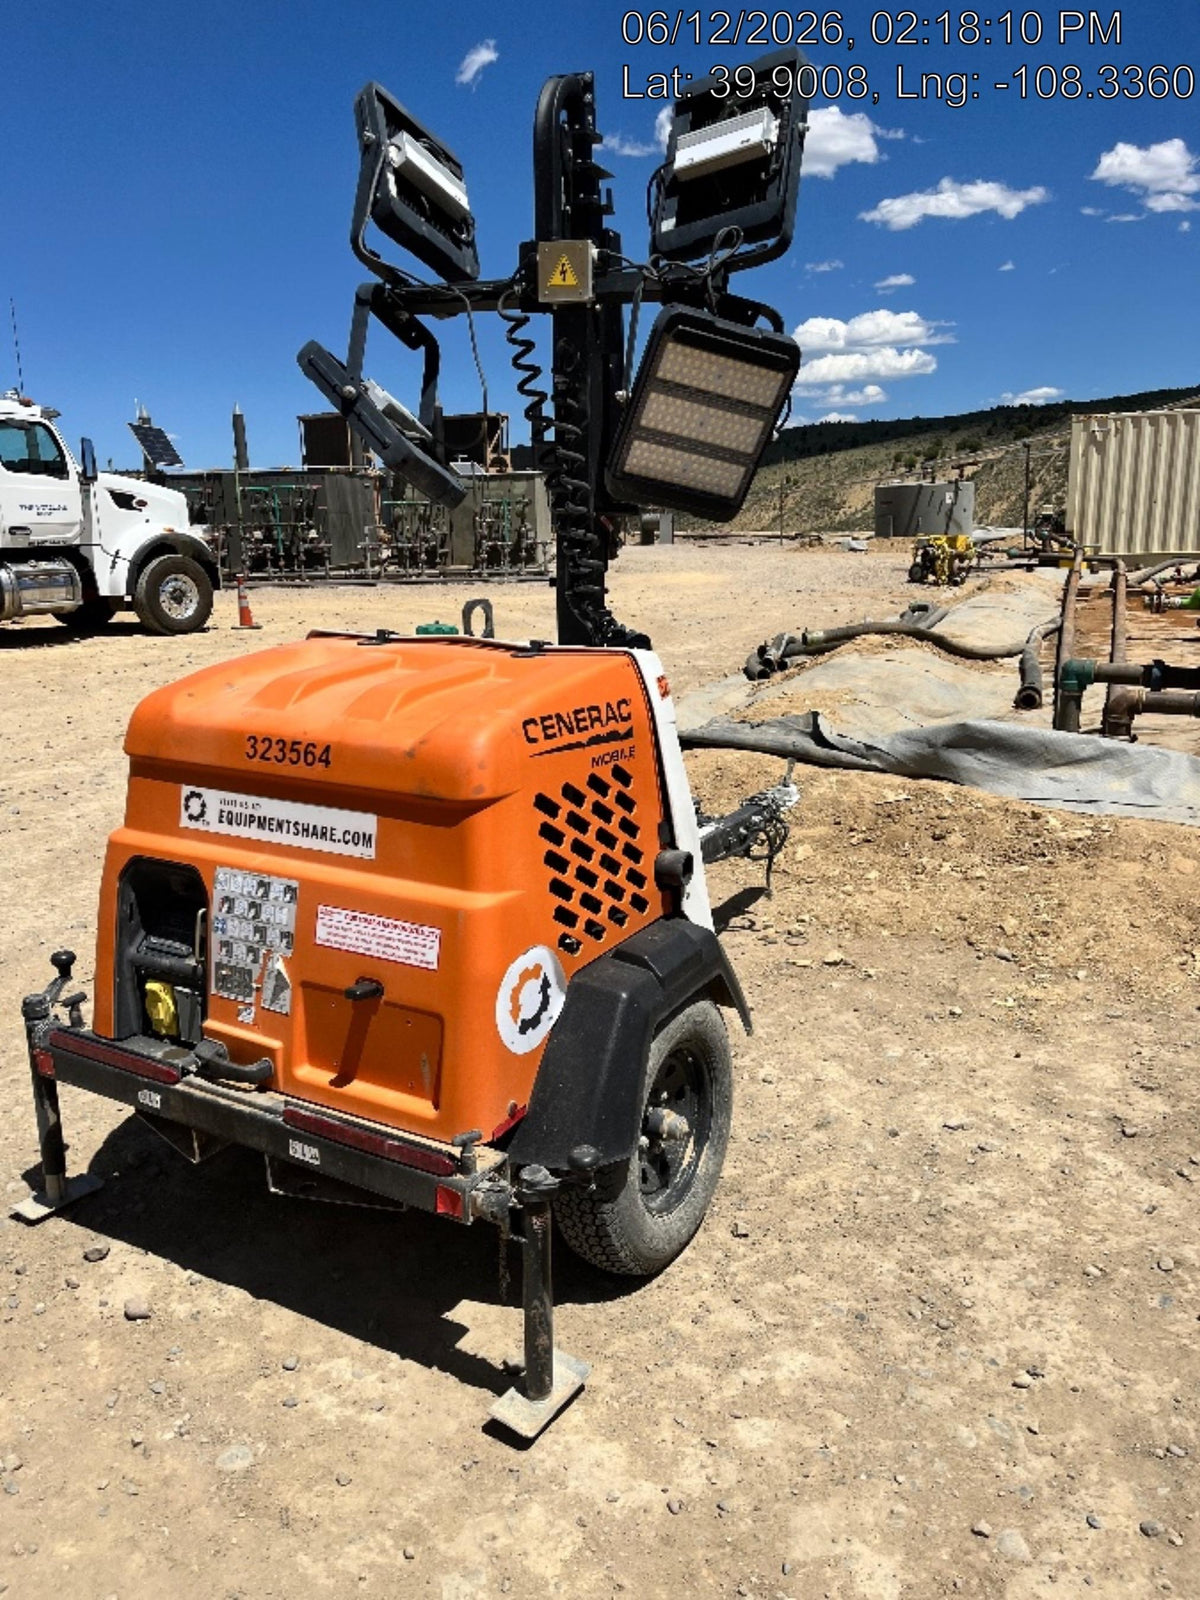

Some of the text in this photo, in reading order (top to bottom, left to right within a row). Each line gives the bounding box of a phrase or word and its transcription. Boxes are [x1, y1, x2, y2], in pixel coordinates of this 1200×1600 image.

[245, 735, 332, 769] 323564
[591, 744, 636, 769] MOBILE
[218, 808, 373, 849] EQUIPMENTSHARE.COM
